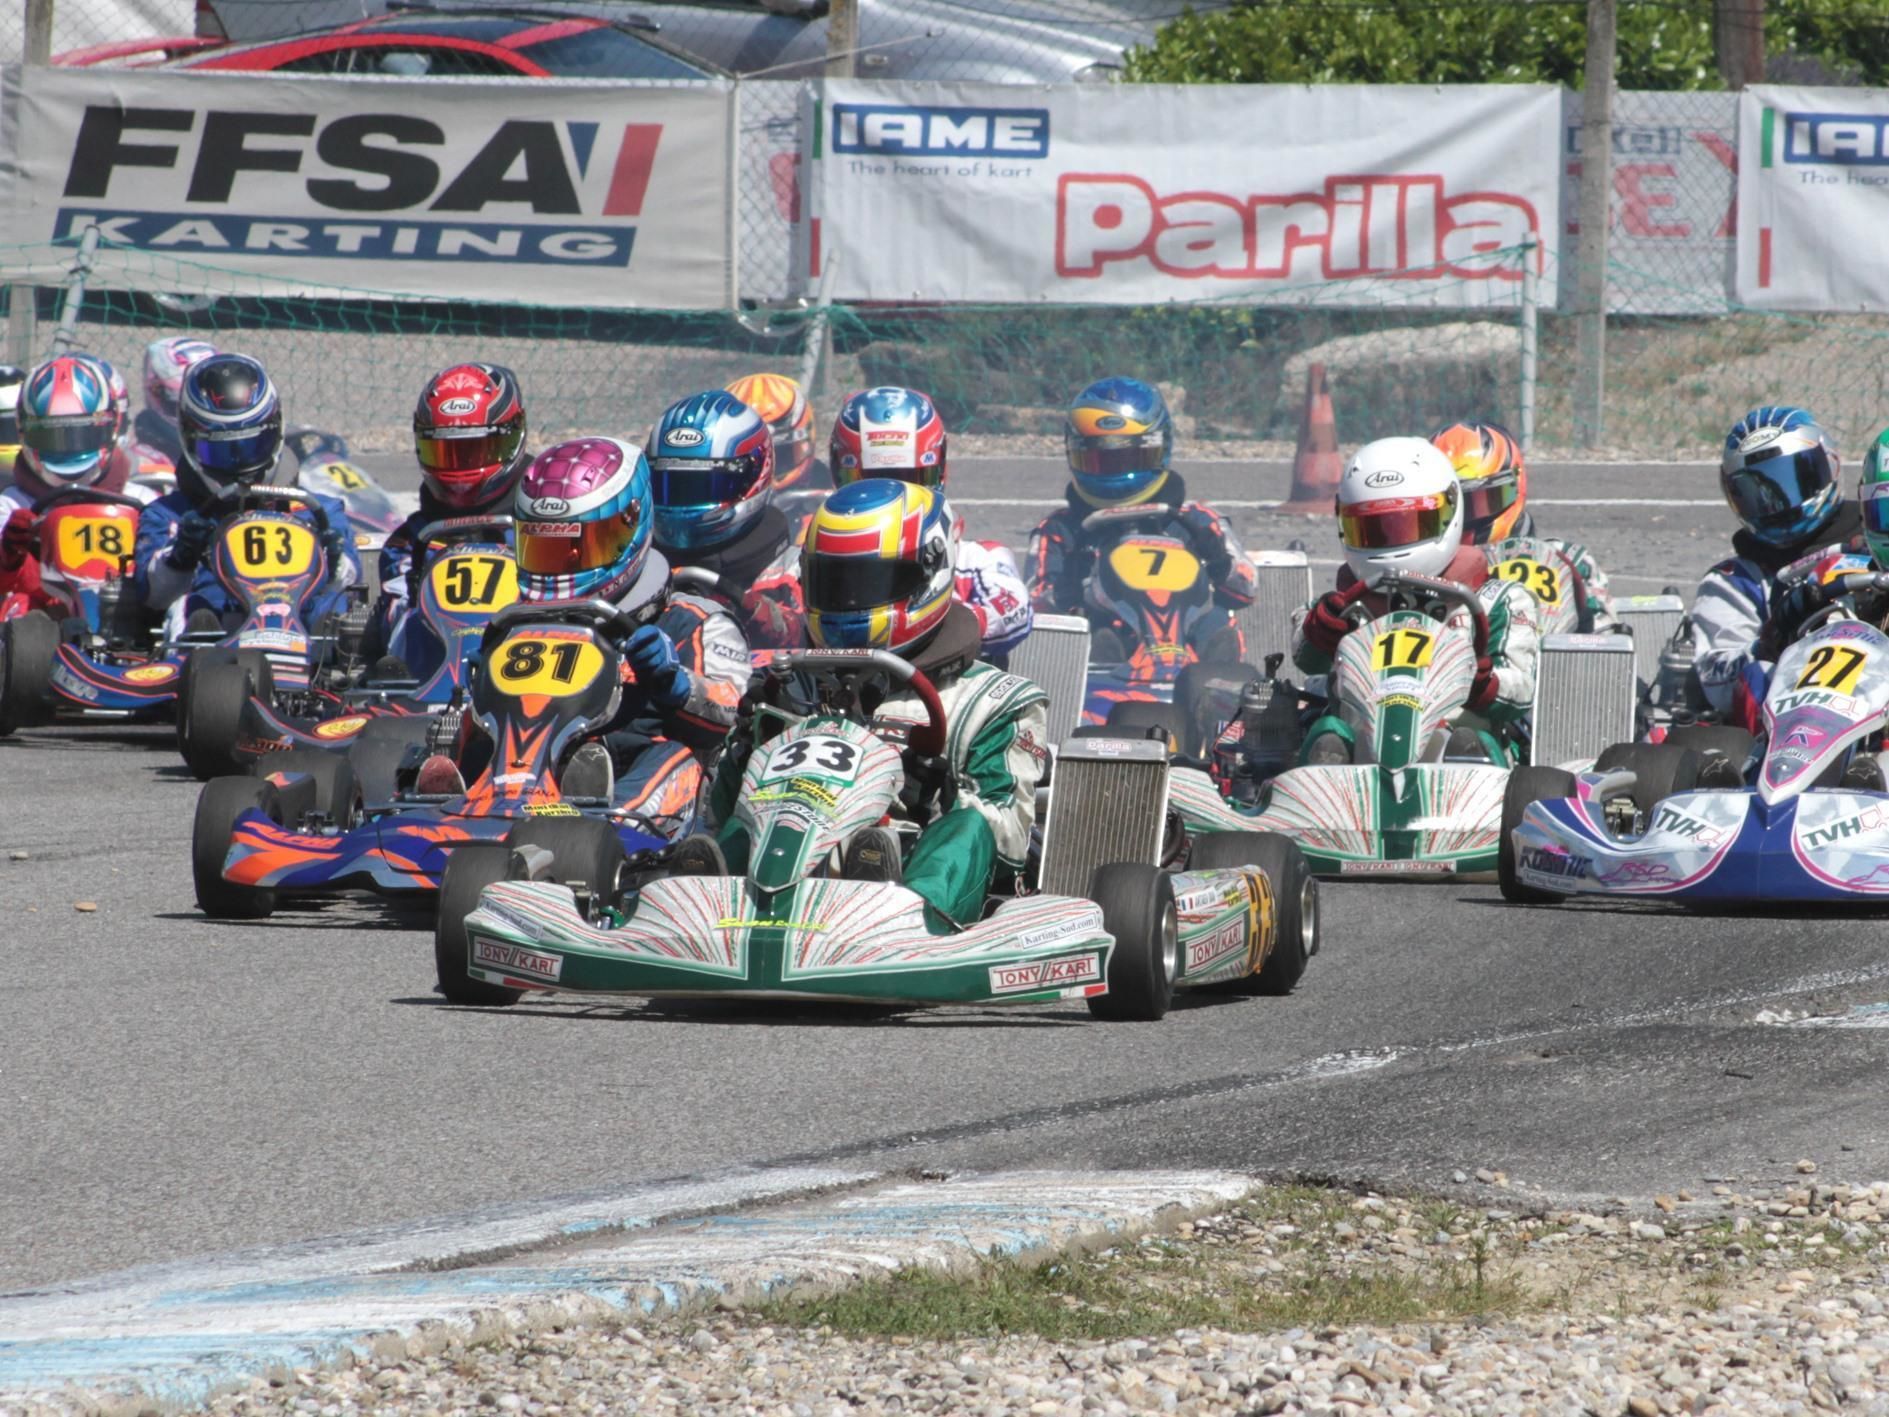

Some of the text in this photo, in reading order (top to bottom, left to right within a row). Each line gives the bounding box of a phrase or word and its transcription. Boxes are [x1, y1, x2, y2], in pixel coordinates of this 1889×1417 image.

[839, 112, 1042, 151] IAME
[1792, 121, 1889, 158] IA
[63, 104, 582, 217] FFSA
[849, 160, 1033, 178] The heart of kart
[1799, 170, 1839, 185] The
[70, 214, 619, 260] KARTING
[1055, 173, 1543, 281] Parilla
[75, 525, 123, 556] 18
[243, 526, 293, 566] 63
[445, 557, 506, 605] 57
[1138, 548, 1168, 577] 7
[500, 640, 584, 684] 81
[1378, 631, 1430, 668] 17
[1797, 645, 1867, 690] 27
[1775, 691, 1831, 714] TVH
[772, 740, 856, 772] 33
[1656, 807, 1706, 838] TVH
[1802, 815, 1863, 847] TVH
